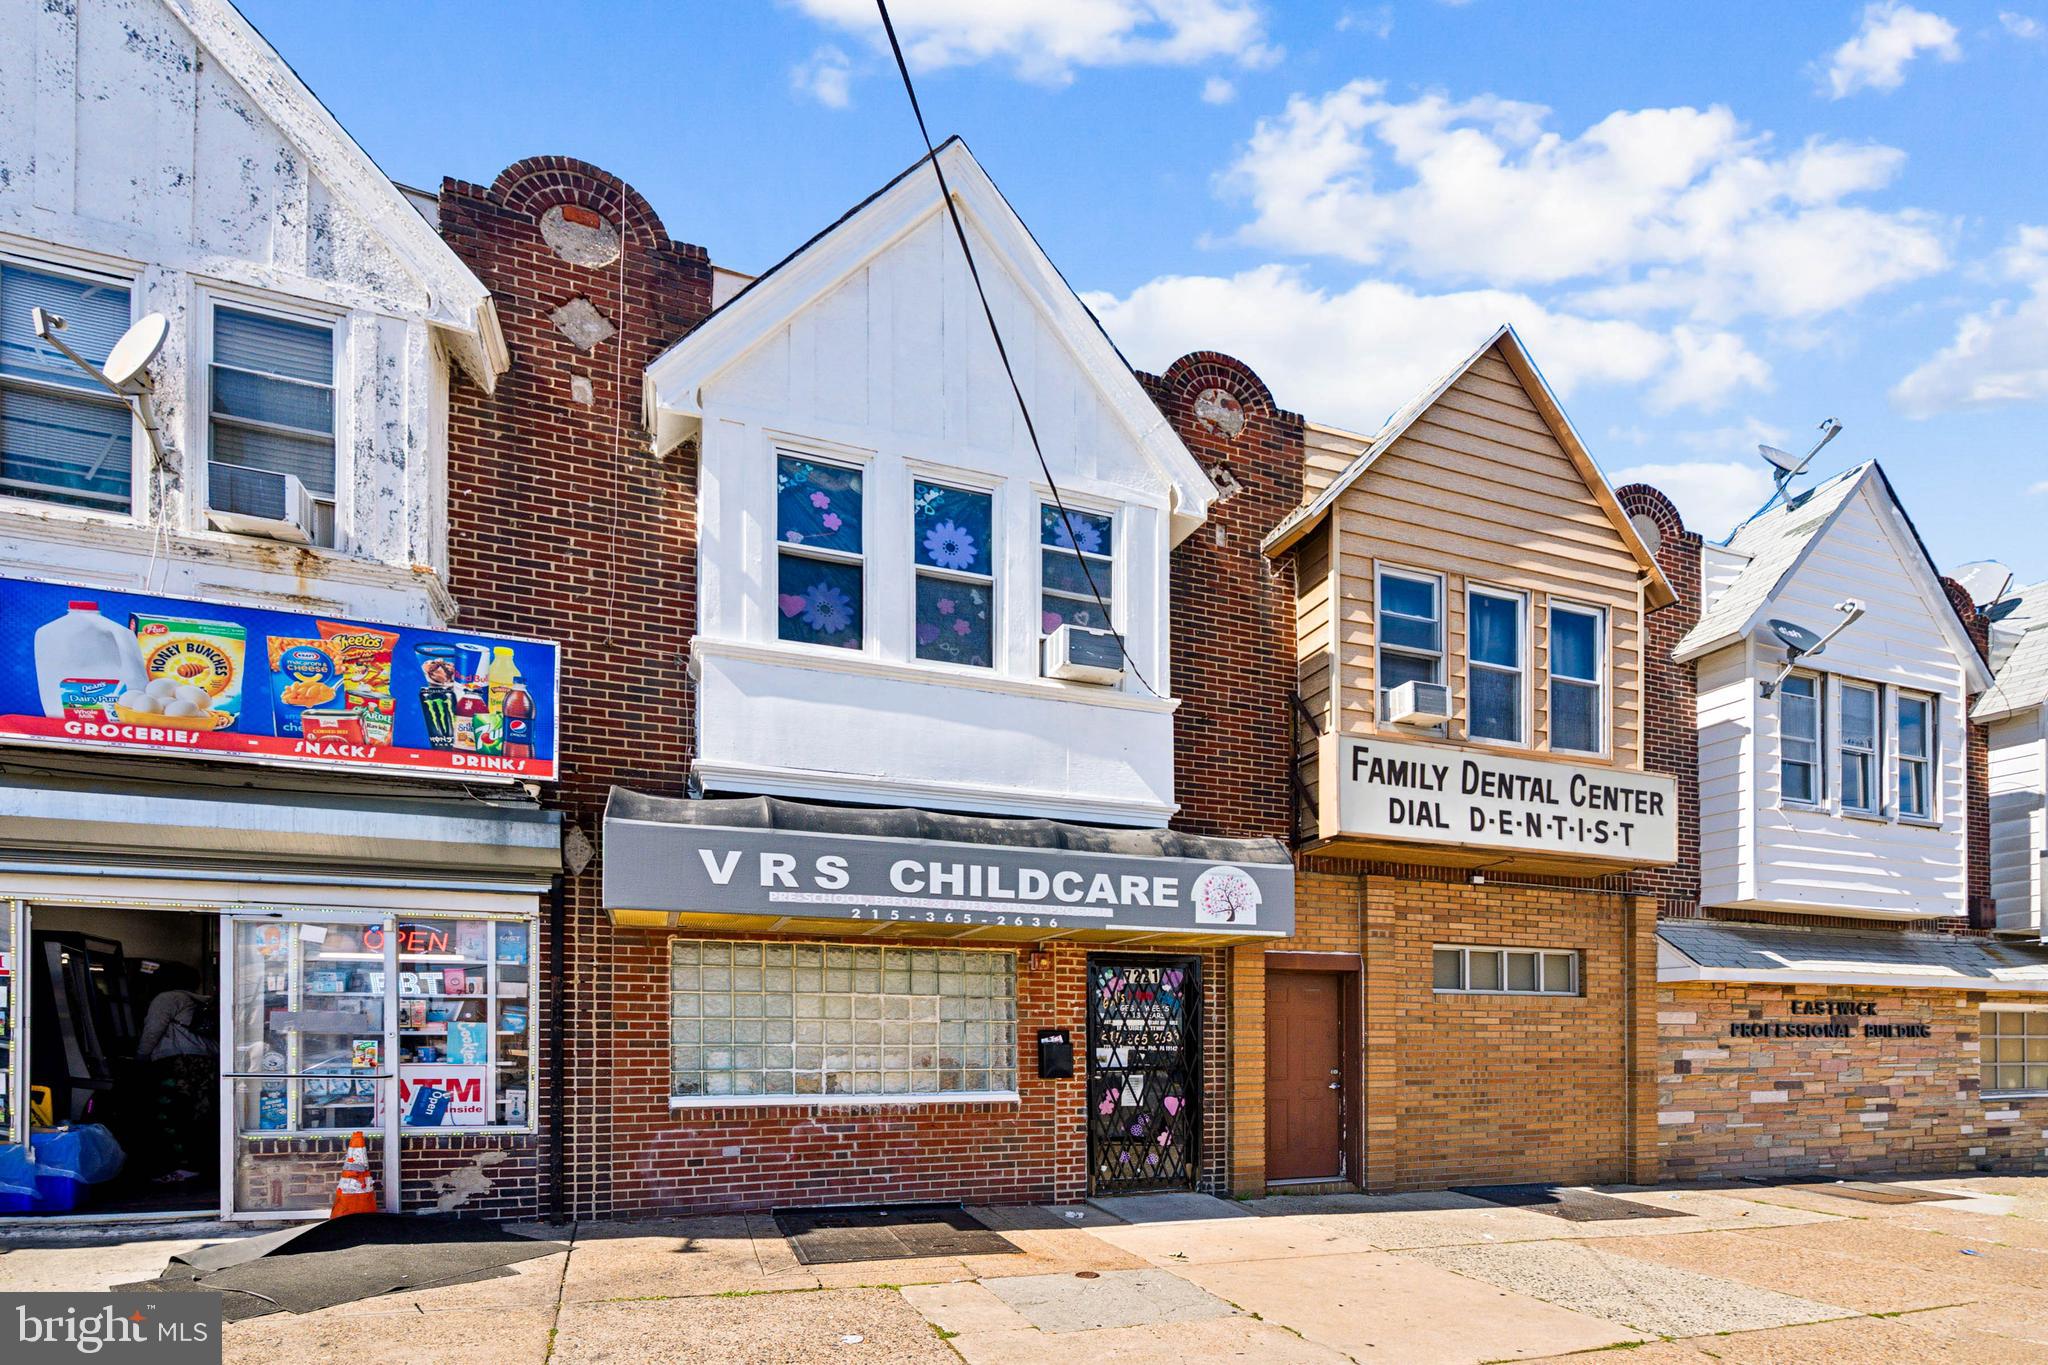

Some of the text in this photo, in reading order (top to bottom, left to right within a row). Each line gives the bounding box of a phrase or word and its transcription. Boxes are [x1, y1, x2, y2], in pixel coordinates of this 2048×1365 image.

[151, 643, 228, 676] HONEY BUNCHES
[474, 674, 489, 682] Bul
[70, 695, 118, 703] DairyPur
[64, 721, 200, 744] GROCERIES
[294, 741, 377, 758] SNACKS
[451, 754, 526, 771] DRINKS
[1352, 745, 1664, 816] FAMILY DENTAL CENTER
[1389, 797, 1450, 829] DIAL
[889, 859, 1179, 907] CHILDCARE
[874, 895, 929, 908] BEFORE
[948, 900, 989, 911] AFTER
[991, 902, 1046, 914] SCHOOL
[852, 908, 1058, 928] 215-365-2636
[370, 972, 443, 995] EBT
[1792, 1000, 1877, 1015] EASTWICK
[1730, 1023, 1931, 1038] PROFESSIONAL BUILDING
[425, 1091, 442, 1116] Open
